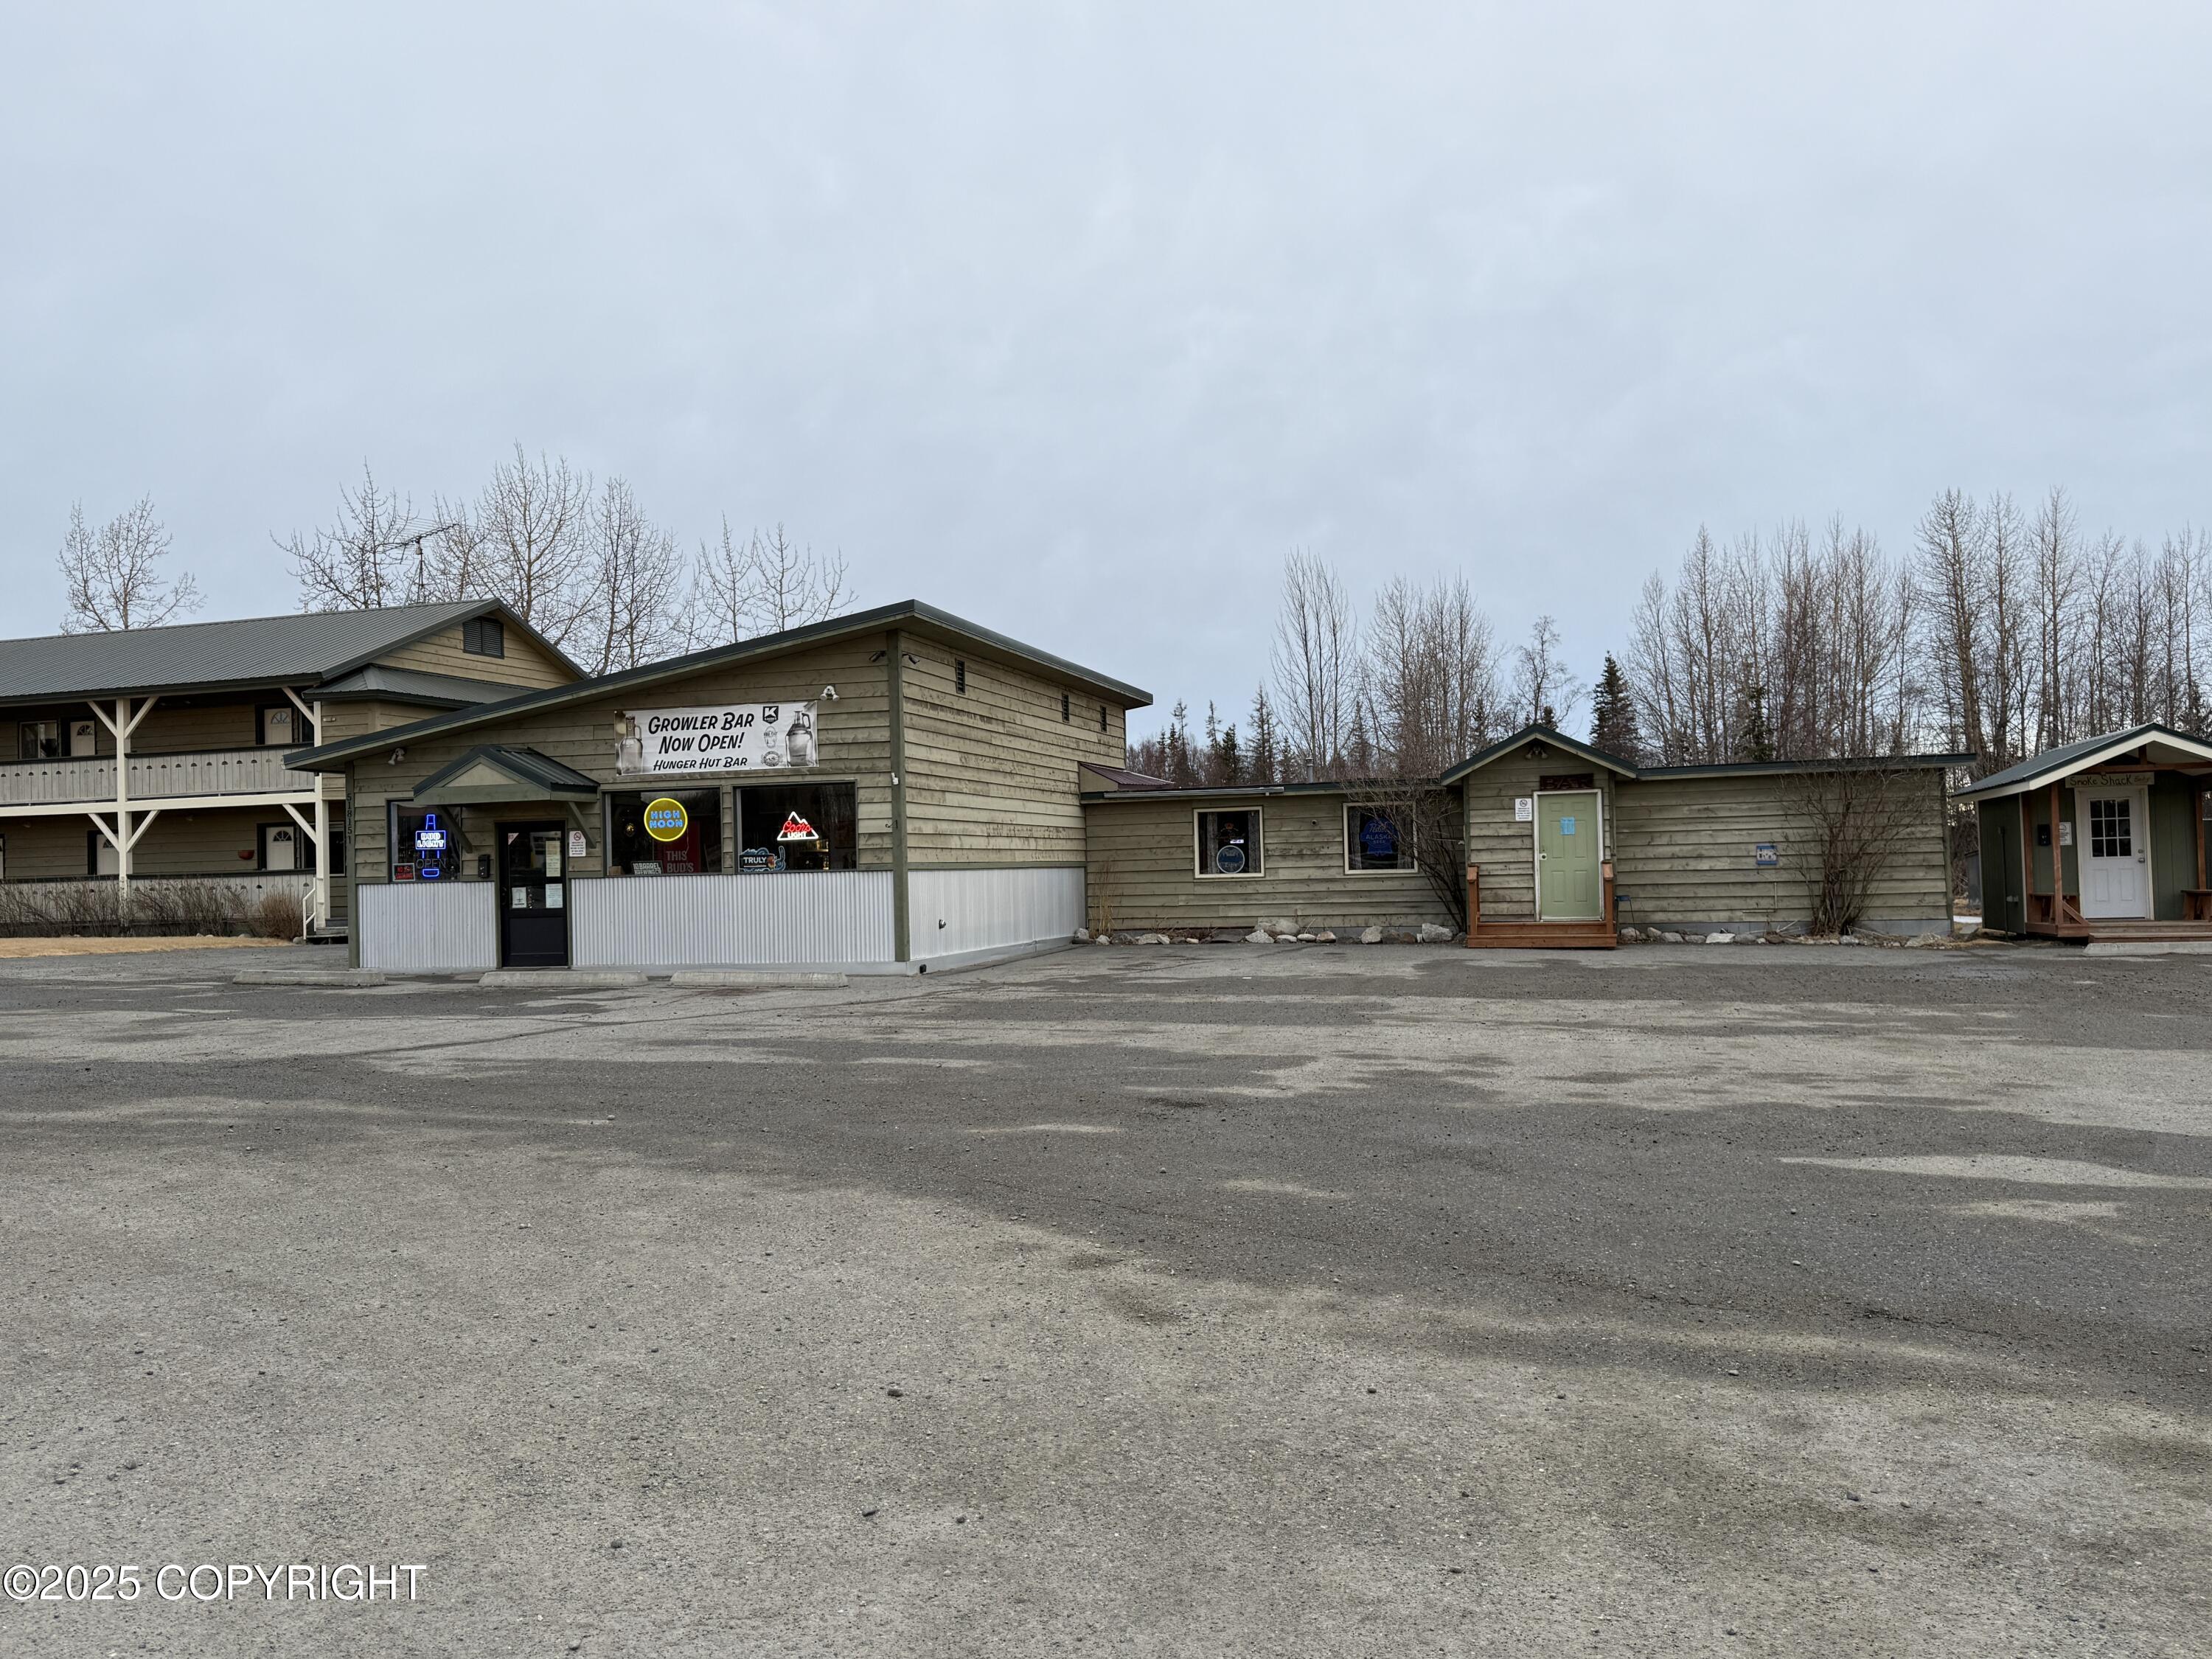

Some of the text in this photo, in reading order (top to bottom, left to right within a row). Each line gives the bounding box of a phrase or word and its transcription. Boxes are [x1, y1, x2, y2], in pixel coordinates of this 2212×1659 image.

[648, 712, 754, 734] GROWLER BAR
[658, 732, 745, 754] NOW OPEN!
[653, 757, 748, 771] HUNGER HUT BAR
[651, 810, 680, 819] HIGH
[650, 819, 683, 828] NOON
[782, 820, 813, 832] Coors
[421, 832, 441, 841] BUD
[417, 840, 445, 848] LIGHT
[667, 851, 687, 860] THIS
[416, 859, 447, 869] OPEN
[667, 863, 694, 873] BUD'S
